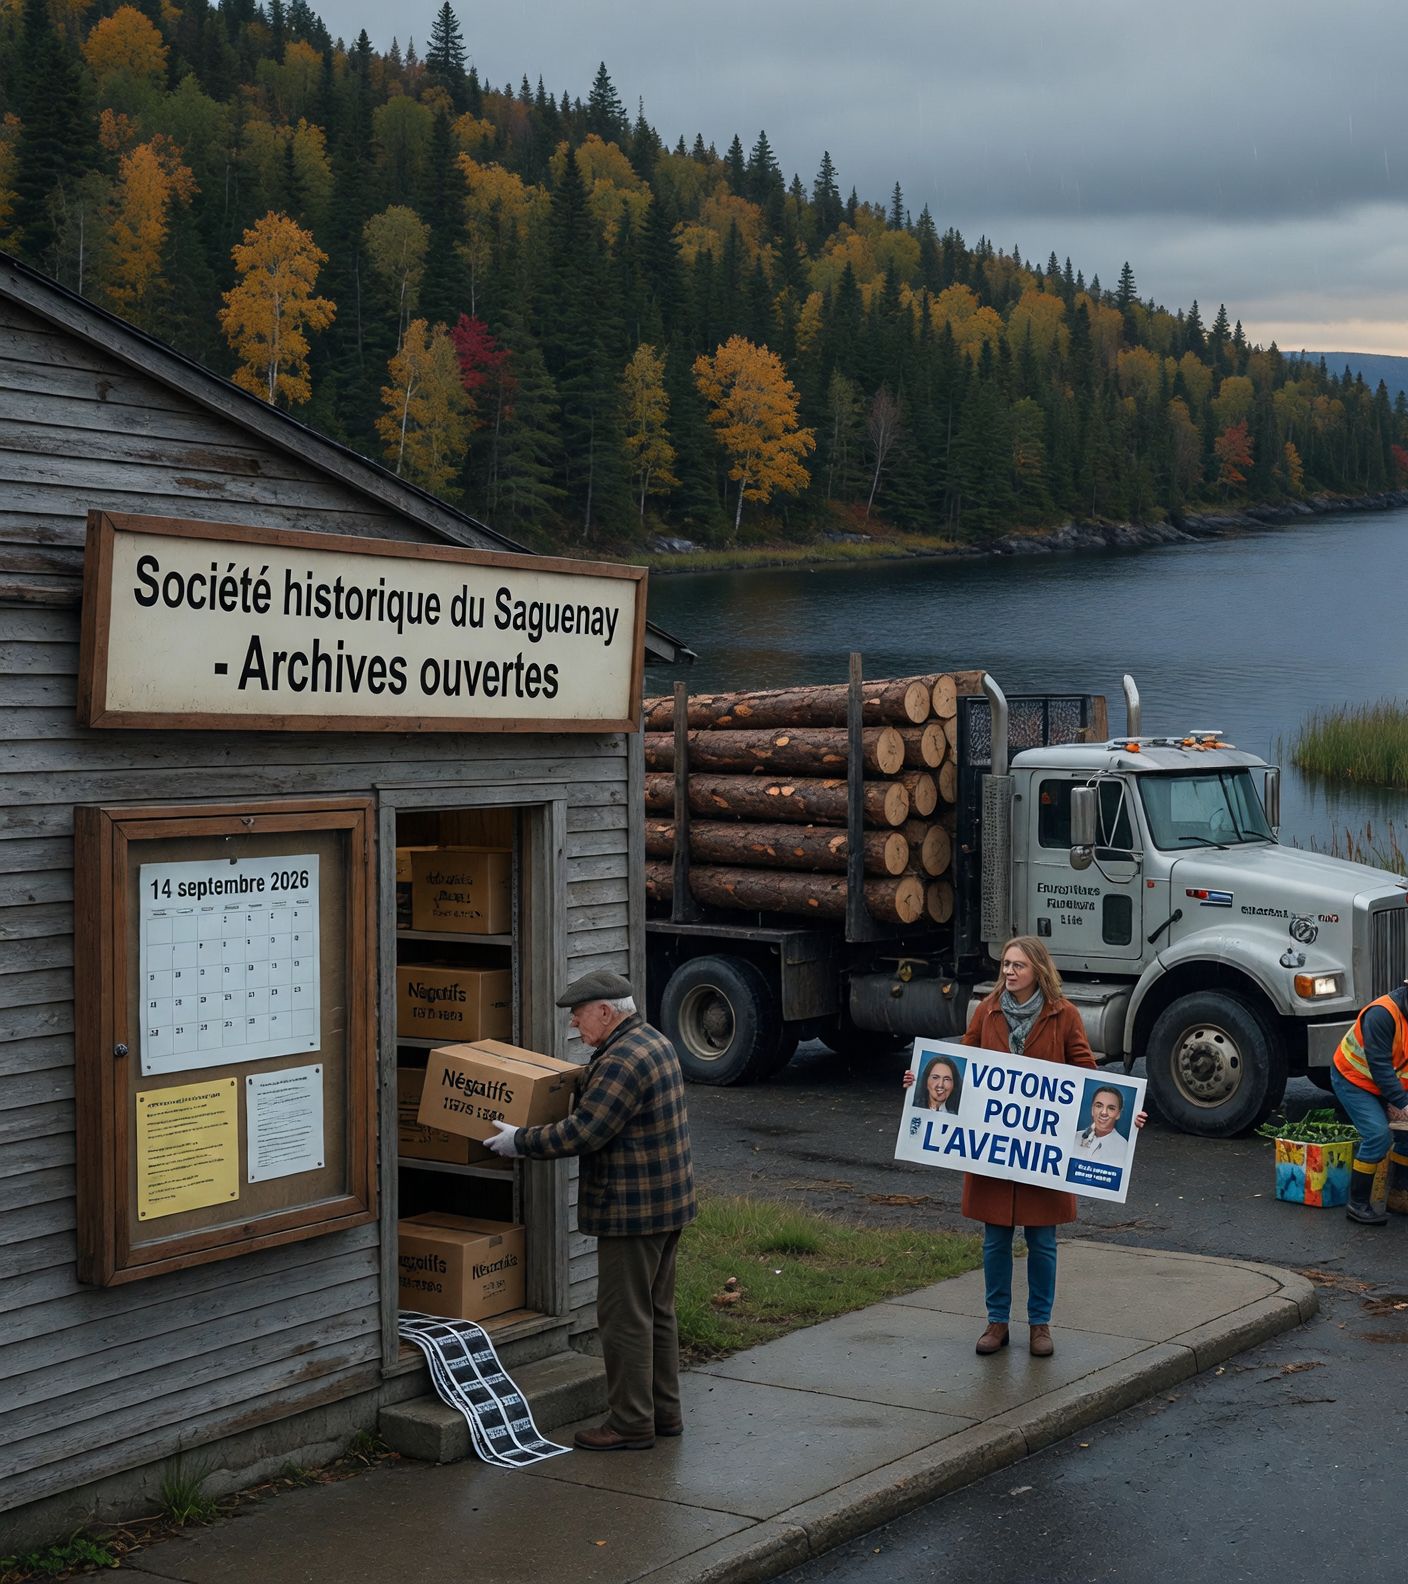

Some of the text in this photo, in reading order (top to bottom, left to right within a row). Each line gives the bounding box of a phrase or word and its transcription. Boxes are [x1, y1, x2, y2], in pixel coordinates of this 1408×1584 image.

[133, 555, 620, 646] Société historique du Saguenay
[238, 635, 408, 695] Archives
[419, 652, 559, 698] ouvertes
[150, 870, 309, 900] 14 septembre 2026
[971, 1063, 1076, 1105] VOTONS
[983, 1098, 1060, 1137] POUR
[922, 1121, 1063, 1177] L'AVENIR
